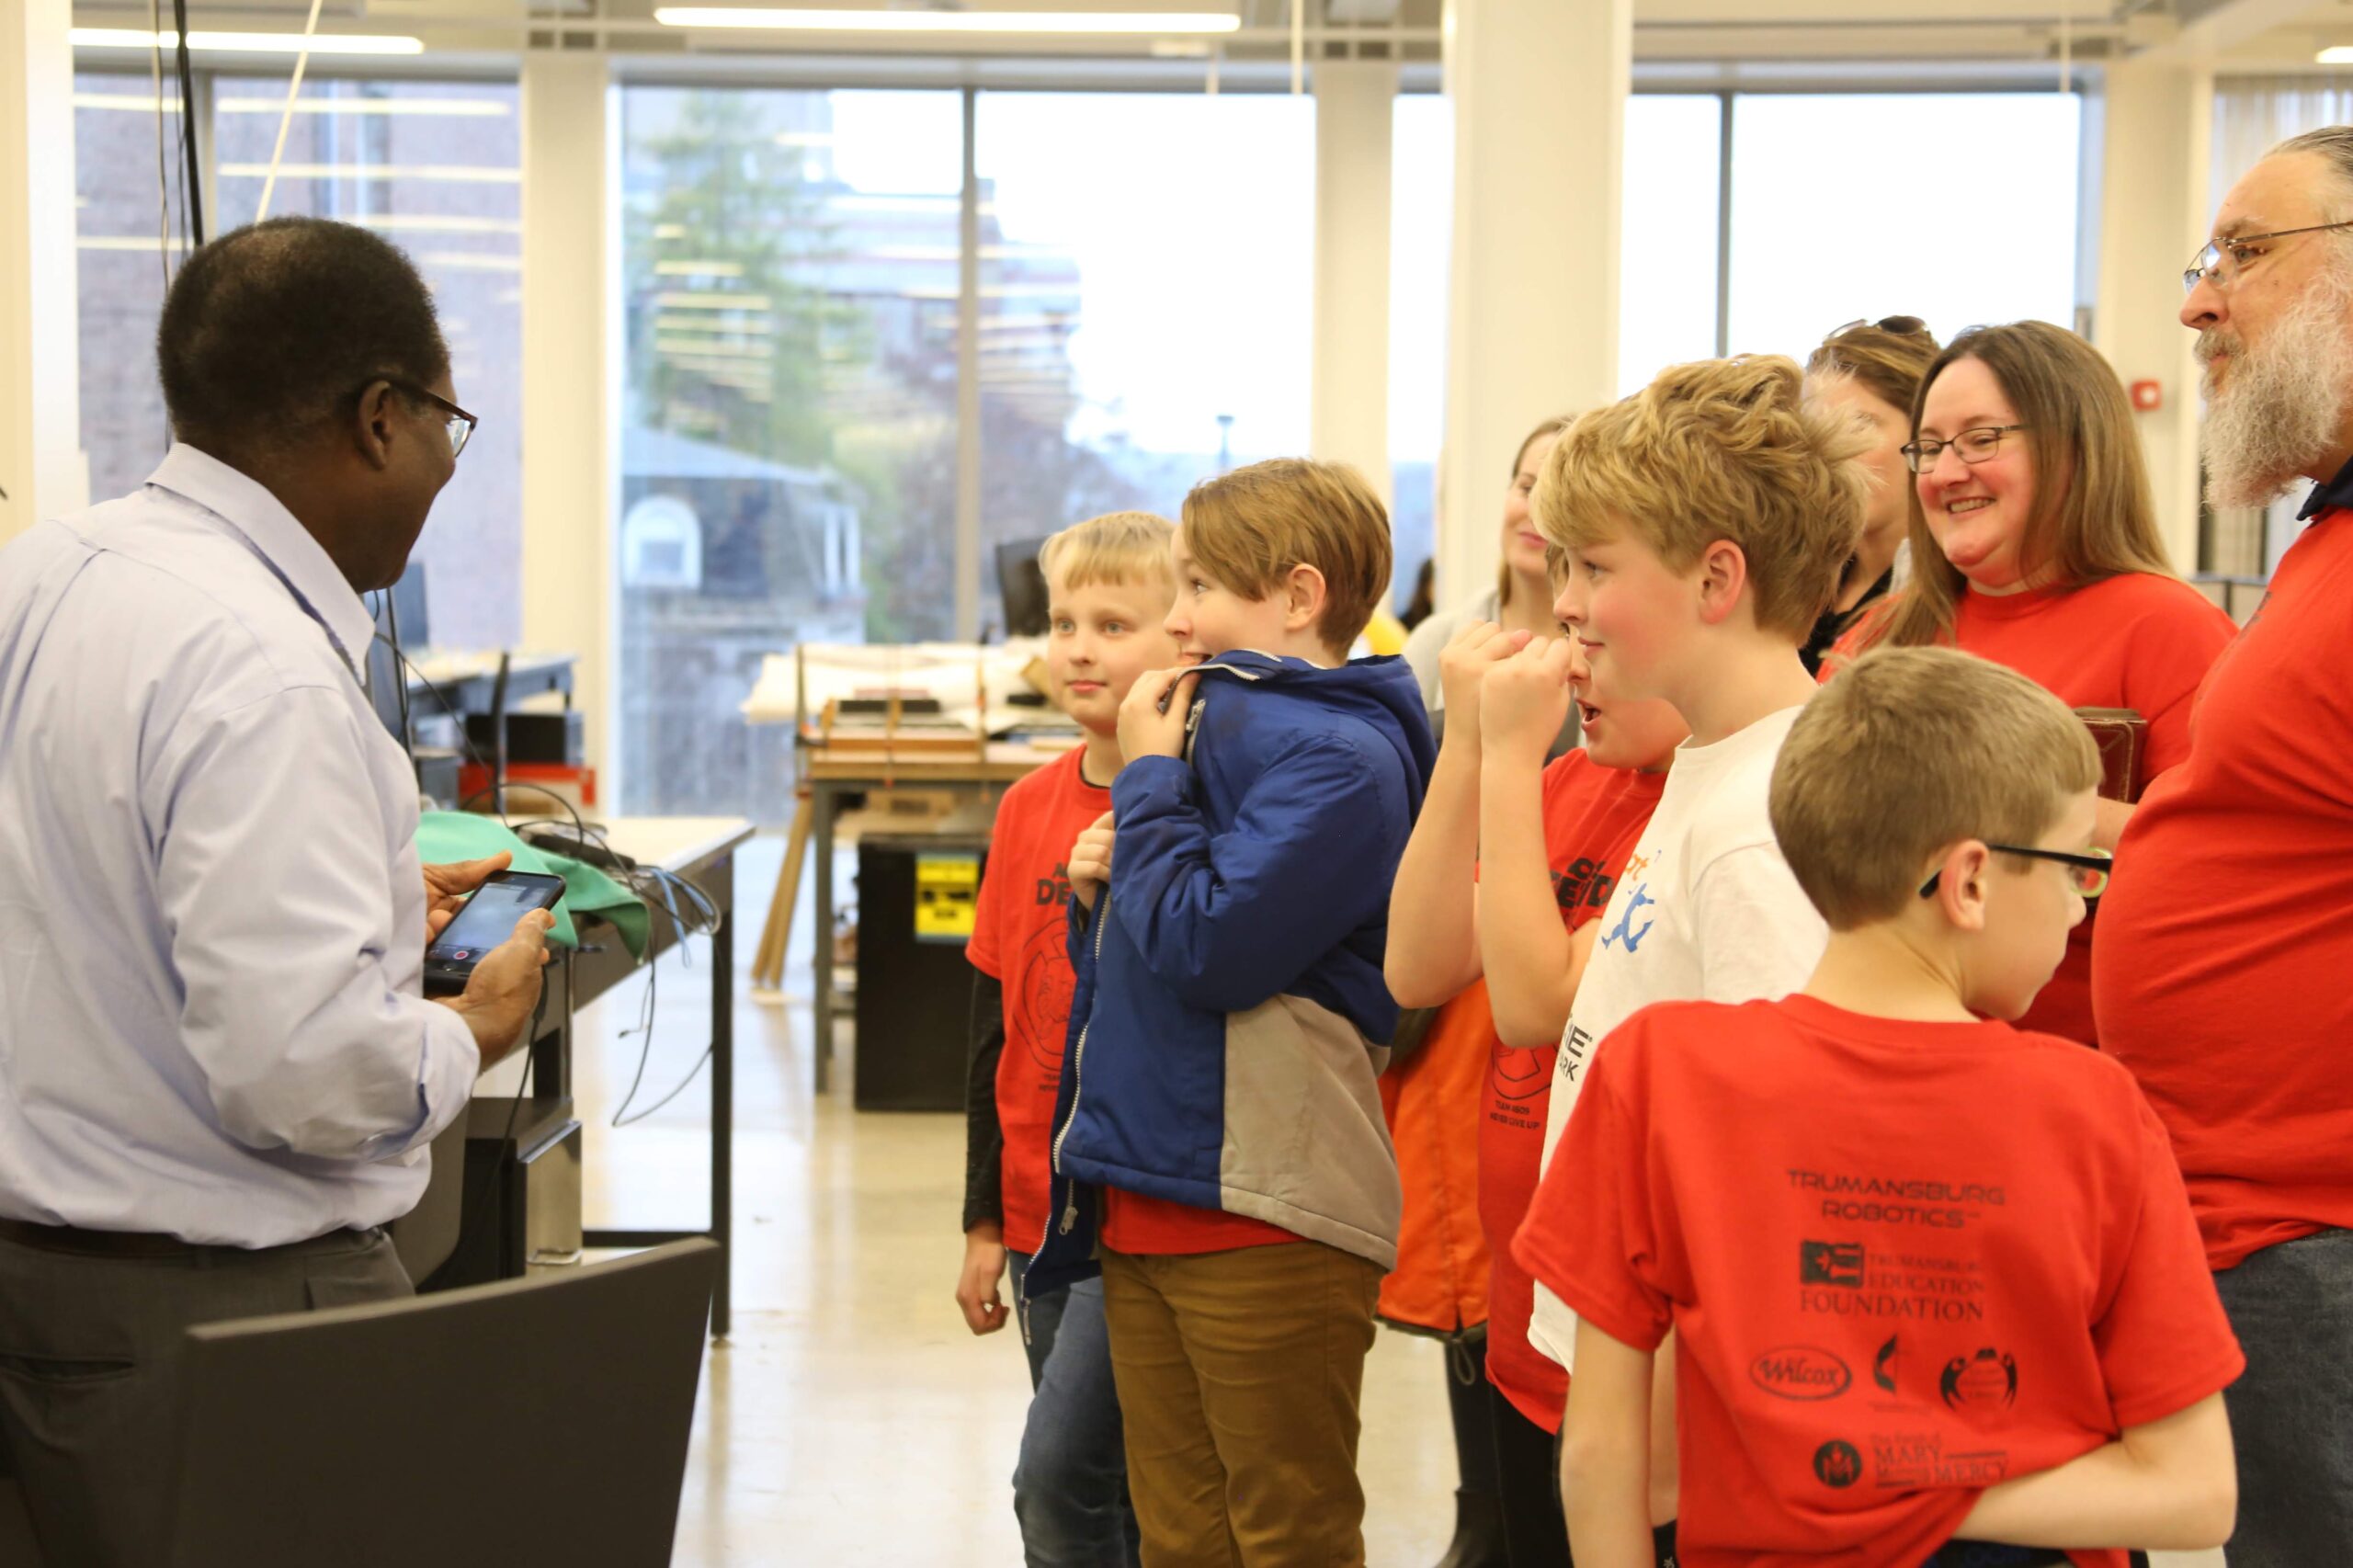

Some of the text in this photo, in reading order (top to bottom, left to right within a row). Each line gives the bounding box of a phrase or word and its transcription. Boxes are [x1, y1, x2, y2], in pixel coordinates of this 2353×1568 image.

[1788, 1170, 2005, 1205] TRUMANSBURG
[1868, 1272, 1985, 1294] EDUCATION
[1801, 1290, 1983, 1322] FOUNDATION
[1758, 1357, 1838, 1385] Wilcox
[1873, 1444, 1941, 1464] MARY
[1934, 1462, 2008, 1484] MERCY
